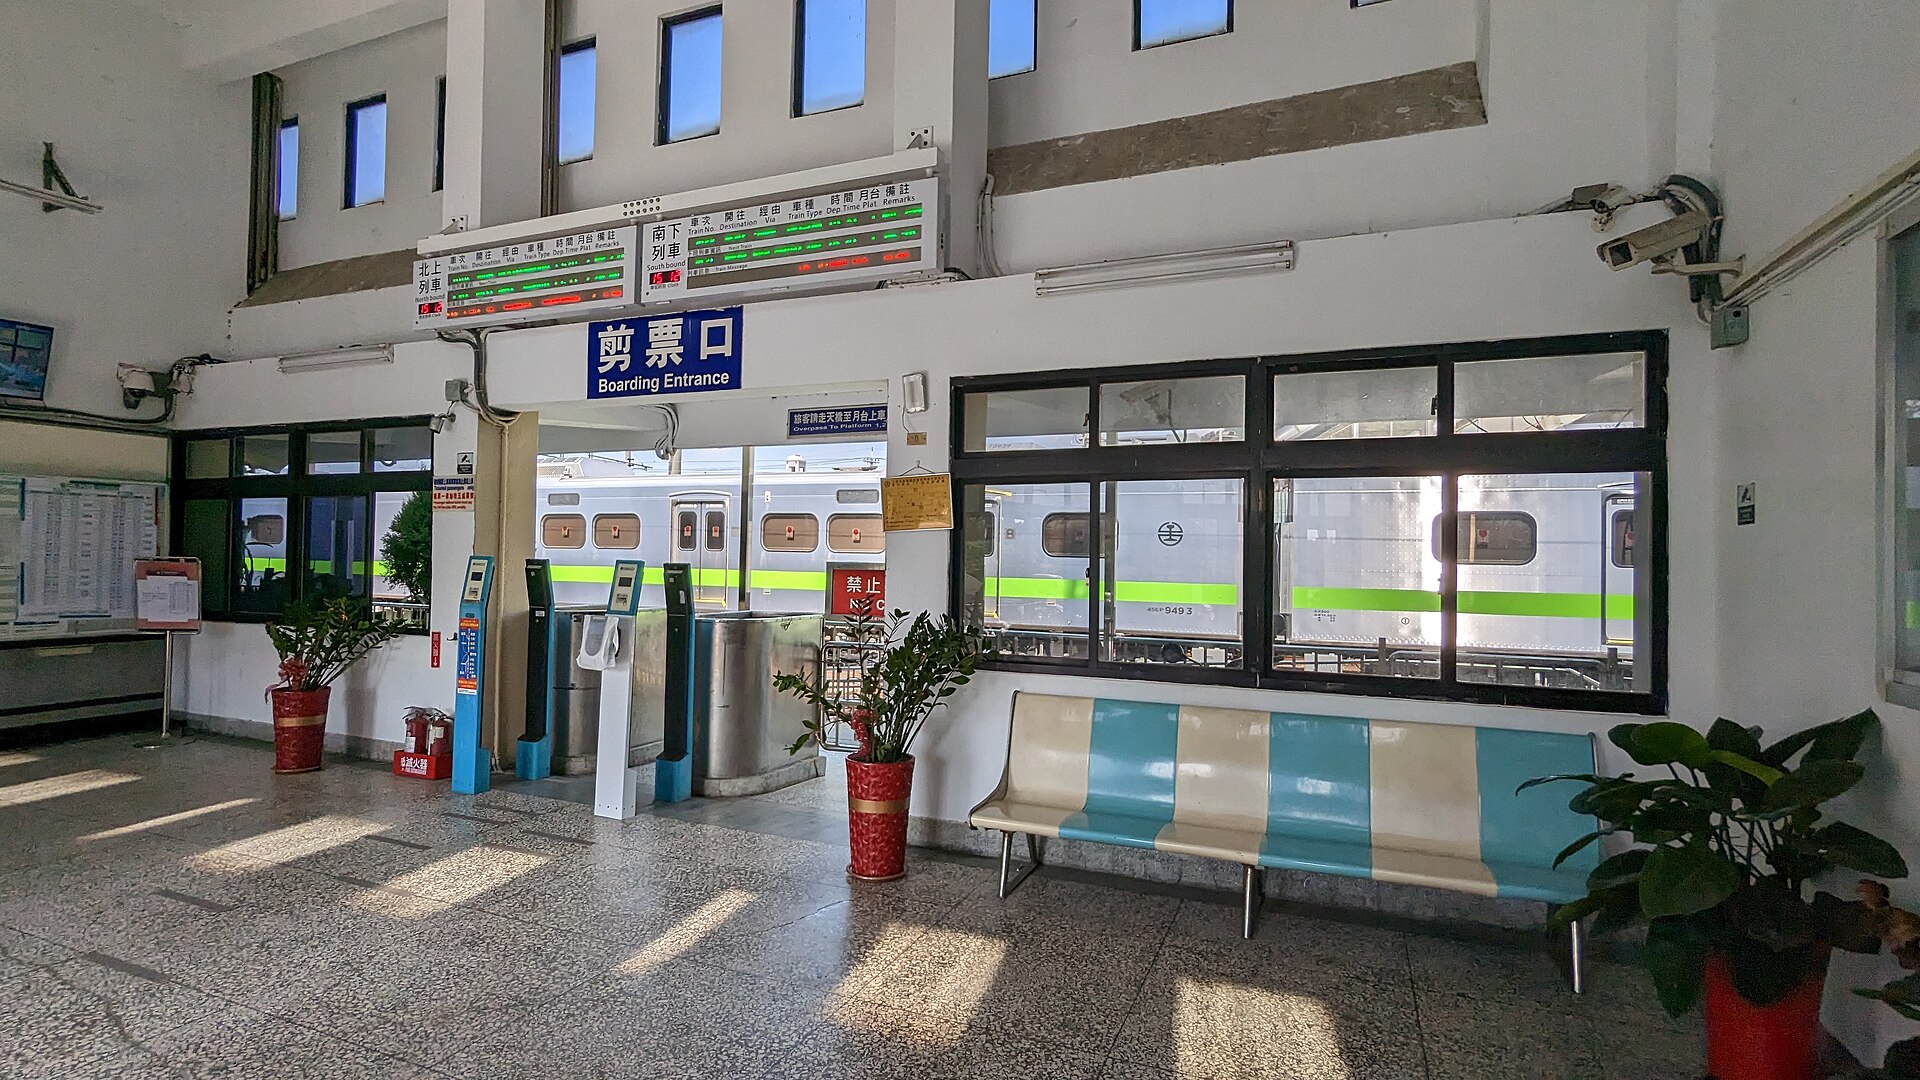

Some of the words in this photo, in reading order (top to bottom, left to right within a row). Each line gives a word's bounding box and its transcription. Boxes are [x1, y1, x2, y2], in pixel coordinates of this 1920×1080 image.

[691, 216, 710, 227] 車次
[725, 210, 745, 222] 開往
[759, 204, 781, 217] 經由
[792, 199, 815, 211] 車種
[830, 192, 854, 206] 時間
[859, 188, 880, 201] 月台
[885, 183, 910, 197] 備註
[688, 228, 703, 236] Train
[720, 219, 758, 231] Destination
[788, 212, 805, 220] Train
[806, 209, 823, 219] Type
[843, 203, 860, 211] Time
[883, 195, 916, 206] Remarks
[578, 234, 594, 245] 月台
[652, 222, 682, 242] 南下
[652, 242, 681, 262] 列車
[418, 260, 442, 277] 北上
[646, 262, 665, 271] South
[665, 260, 686, 269] bound
[418, 278, 442, 294] 列車
[597, 317, 734, 374] 剪票口
[598, 376, 660, 393] Boarding
[663, 372, 730, 388] Entrance
[793, 409, 887, 425] 旅客請走天橋至月台上車
[846, 576, 881, 594] 禁止
[1165, 606, 1193, 615] 9493
